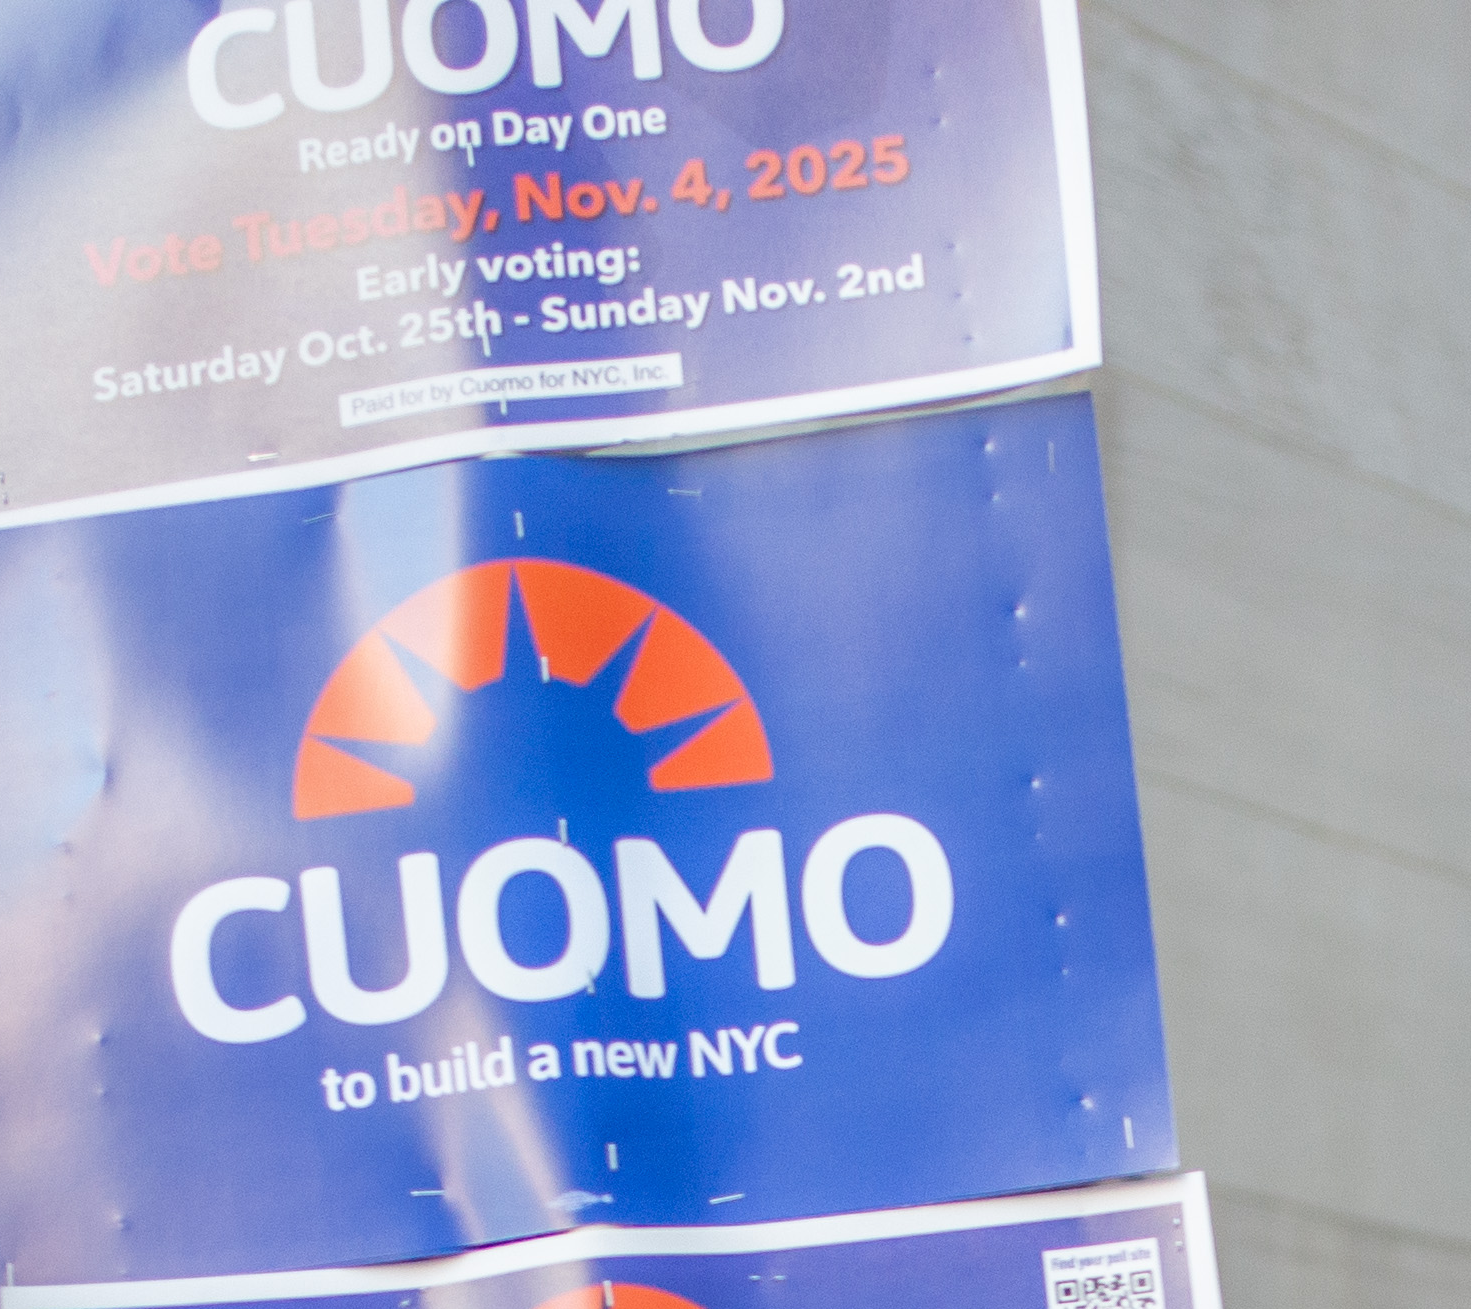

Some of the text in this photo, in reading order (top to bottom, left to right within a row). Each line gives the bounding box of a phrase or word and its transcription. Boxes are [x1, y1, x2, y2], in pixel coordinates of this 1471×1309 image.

[185, 0, 785, 130] CUOMO
[298, 105, 666, 173] Ready on Day One
[85, 135, 909, 286] Vote Tuesday, Nov. 4, 2025
[356, 242, 641, 303] Early voting:
[92, 345, 285, 402] Saturday
[298, 326, 387, 366] Oct.
[396, 301, 502, 349] 25th
[541, 286, 711, 331] Sunday
[722, 277, 826, 313] Nov.
[837, 253, 924, 298] 2nd
[171, 814, 953, 1045] CUOMO
[321, 1021, 803, 1111] to build a new NYC
